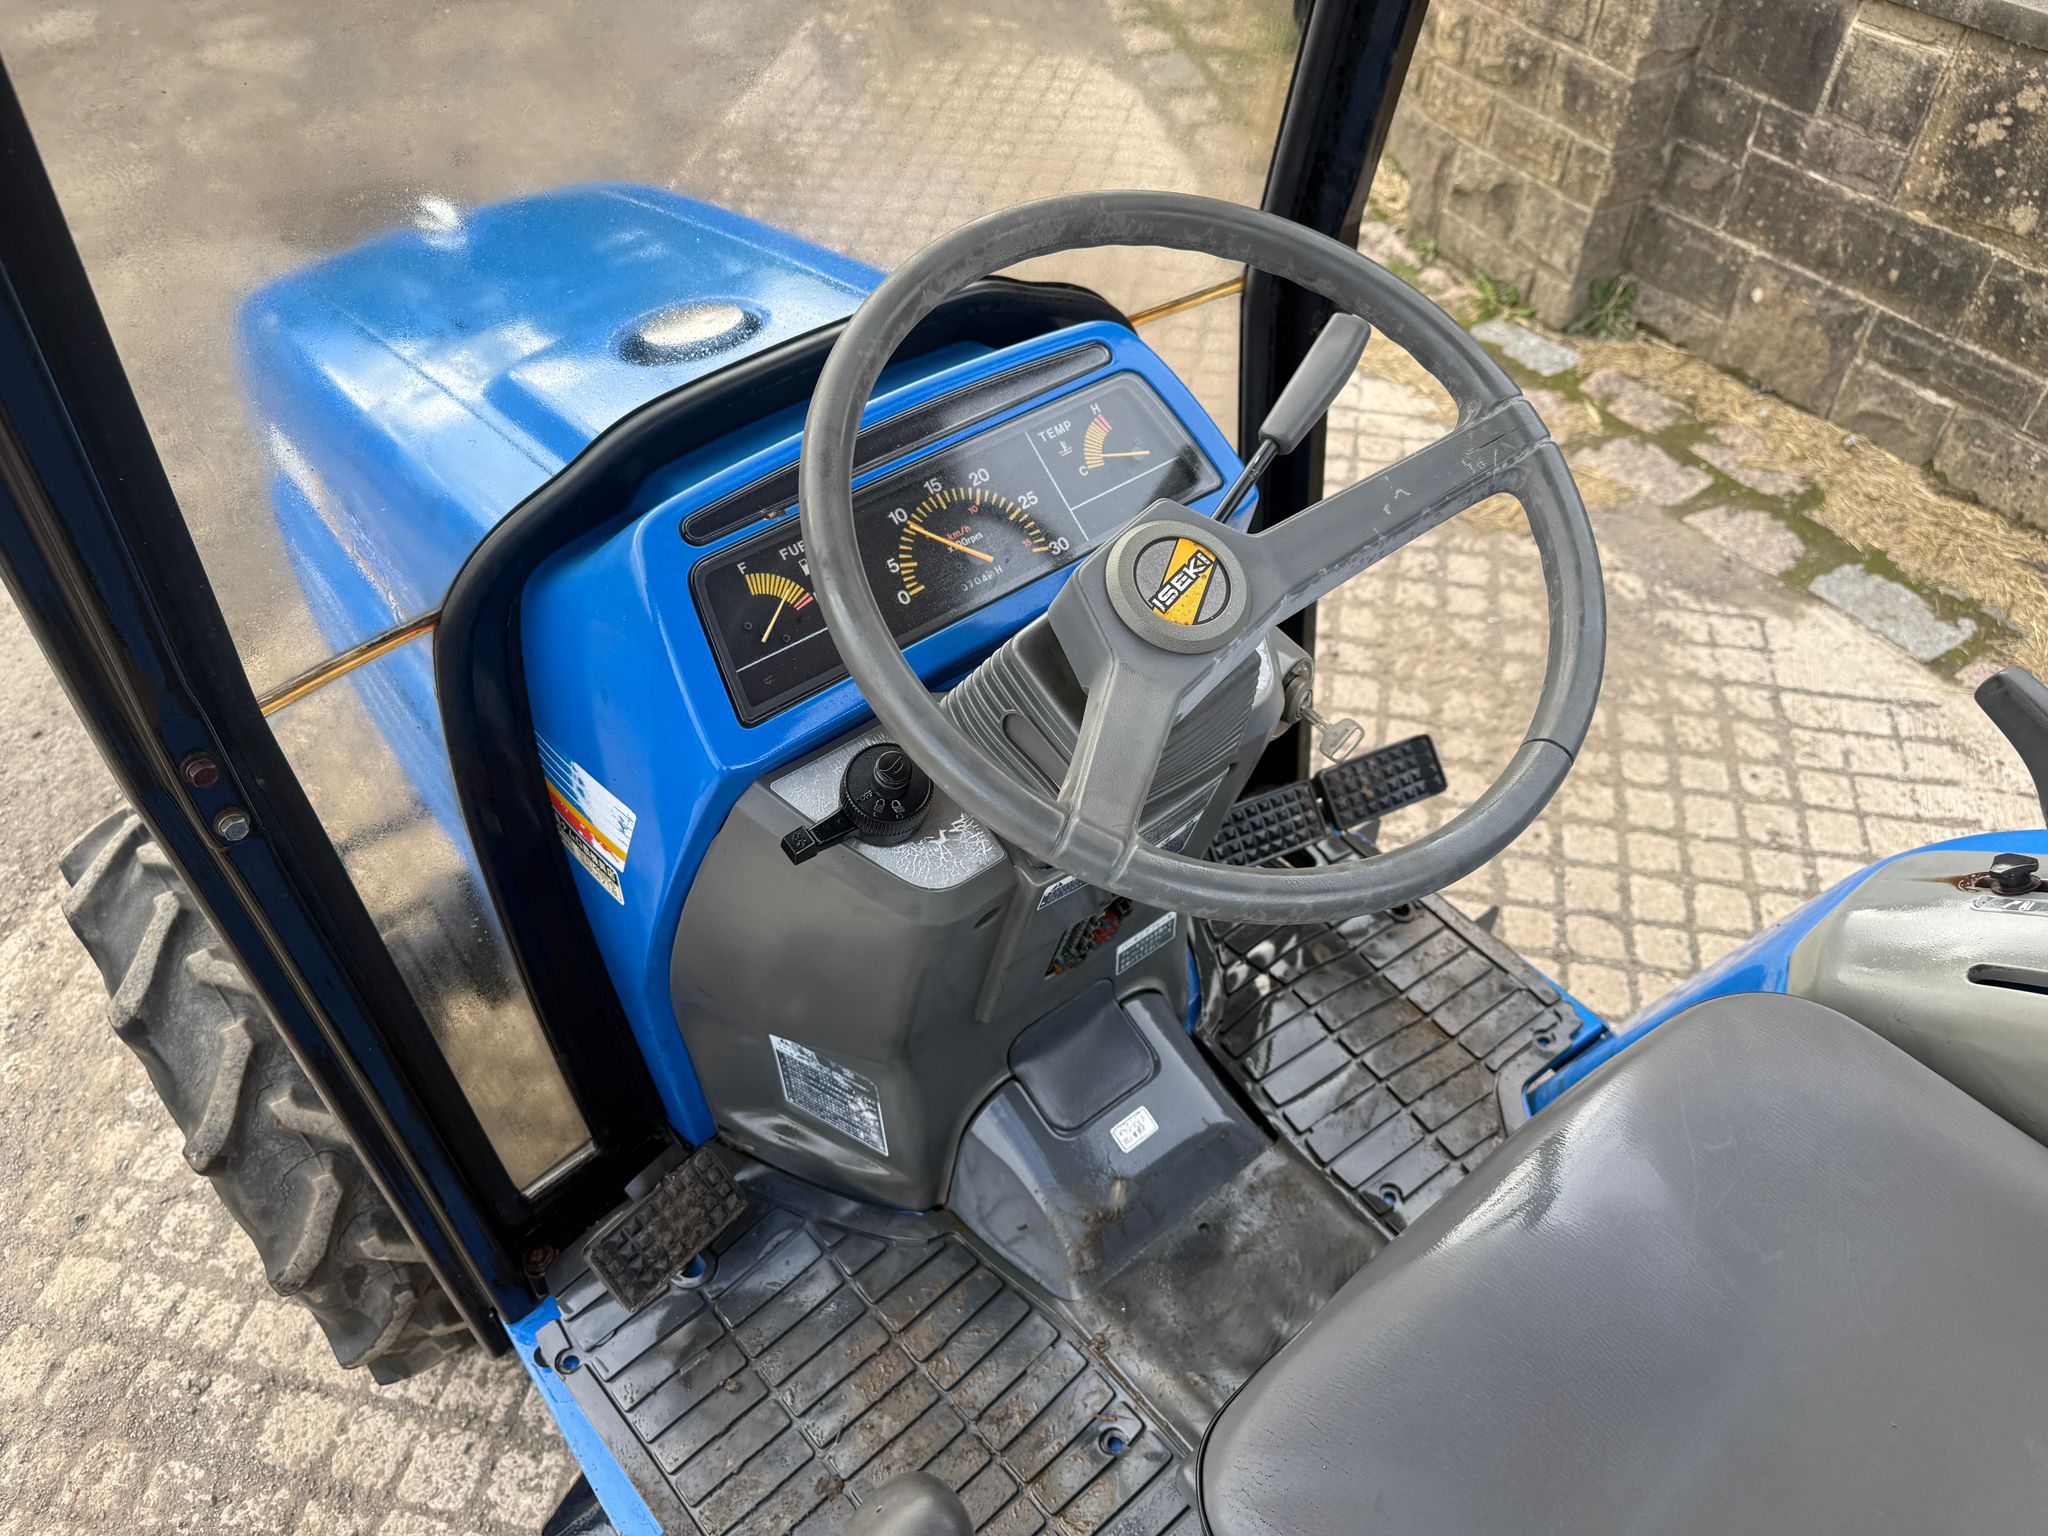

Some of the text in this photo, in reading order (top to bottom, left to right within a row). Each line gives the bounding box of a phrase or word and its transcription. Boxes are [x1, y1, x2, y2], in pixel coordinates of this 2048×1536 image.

[1089, 402, 1102, 415] H
[1037, 420, 1072, 442] TEMP
[968, 467, 990, 487] 20
[1078, 465, 1089, 477] C
[923, 477, 943, 495] 15
[1017, 490, 1039, 510] 25
[887, 507, 908, 526] 10
[968, 504, 979, 515] 10
[947, 524, 972, 541] km/h
[779, 540, 806, 561] FUE
[1048, 536, 1070, 556] 30
[737, 561, 747, 575] F
[886, 558, 900, 574] 5
[1151, 552, 1212, 613] ISEKI
[897, 590, 911, 605] 0
